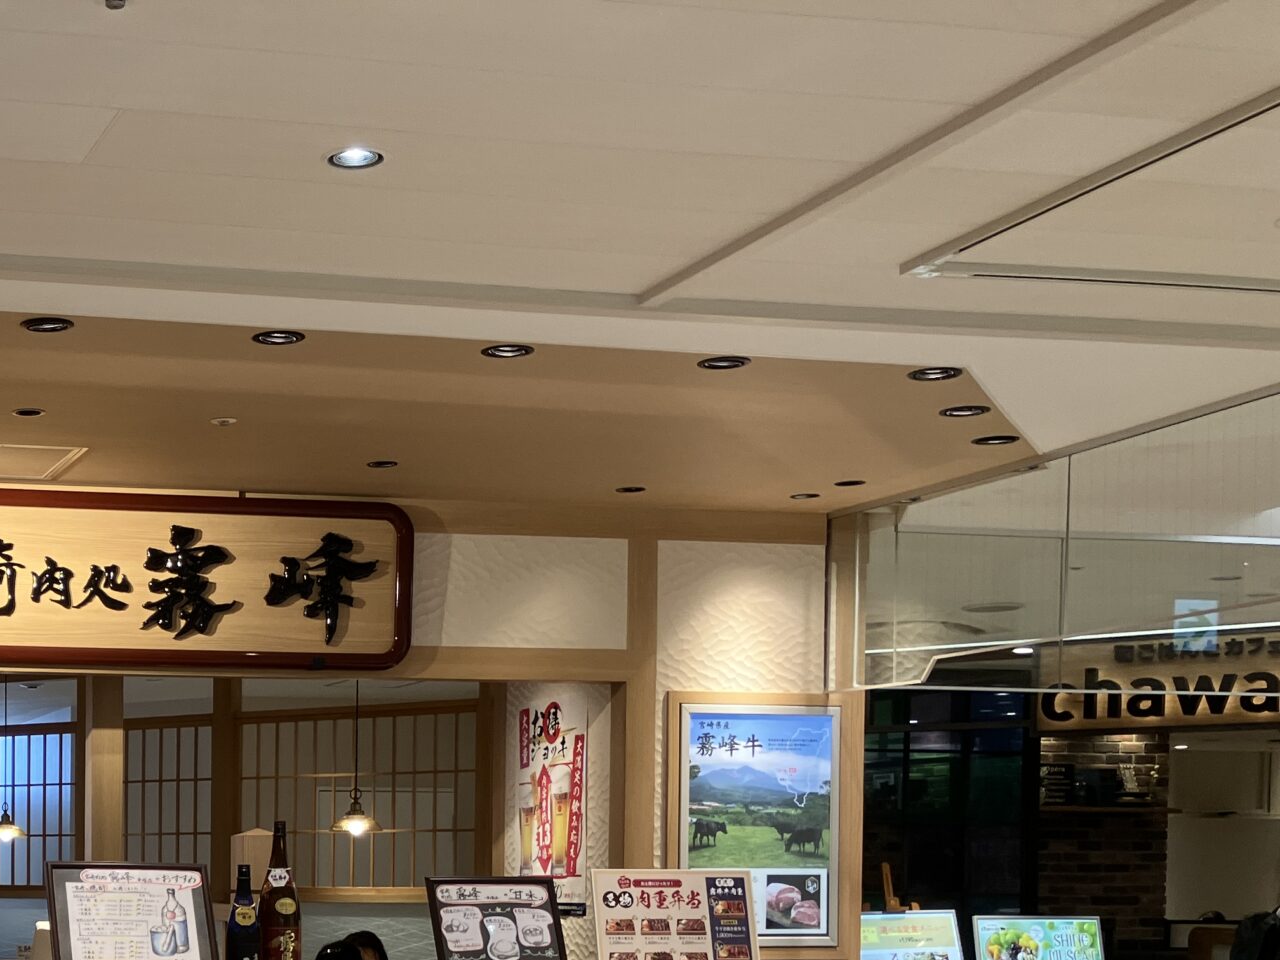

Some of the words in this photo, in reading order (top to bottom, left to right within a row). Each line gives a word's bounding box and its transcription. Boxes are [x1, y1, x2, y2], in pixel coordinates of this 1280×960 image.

[696, 732, 763, 758] 霧峰牛
[1053, 933, 1089, 948] SHINE
